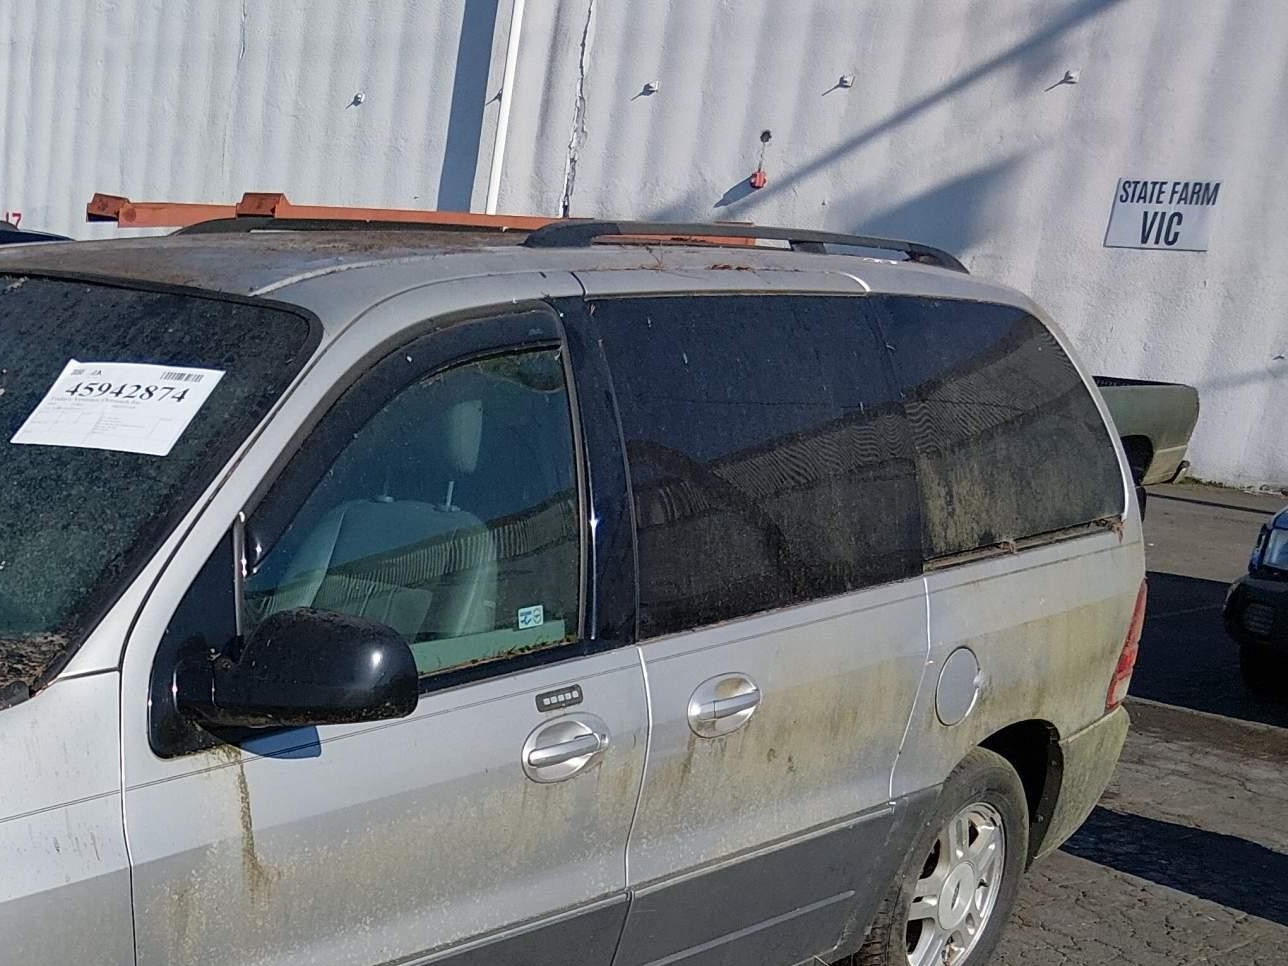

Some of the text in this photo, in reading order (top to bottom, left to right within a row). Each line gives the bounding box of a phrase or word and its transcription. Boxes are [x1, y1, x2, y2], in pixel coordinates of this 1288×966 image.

[1119, 180, 1221, 206] STATE FARM
[5, 211, 22, 230] 17
[1140, 210, 1184, 246] VIC
[65, 382, 190, 402] 45942874
